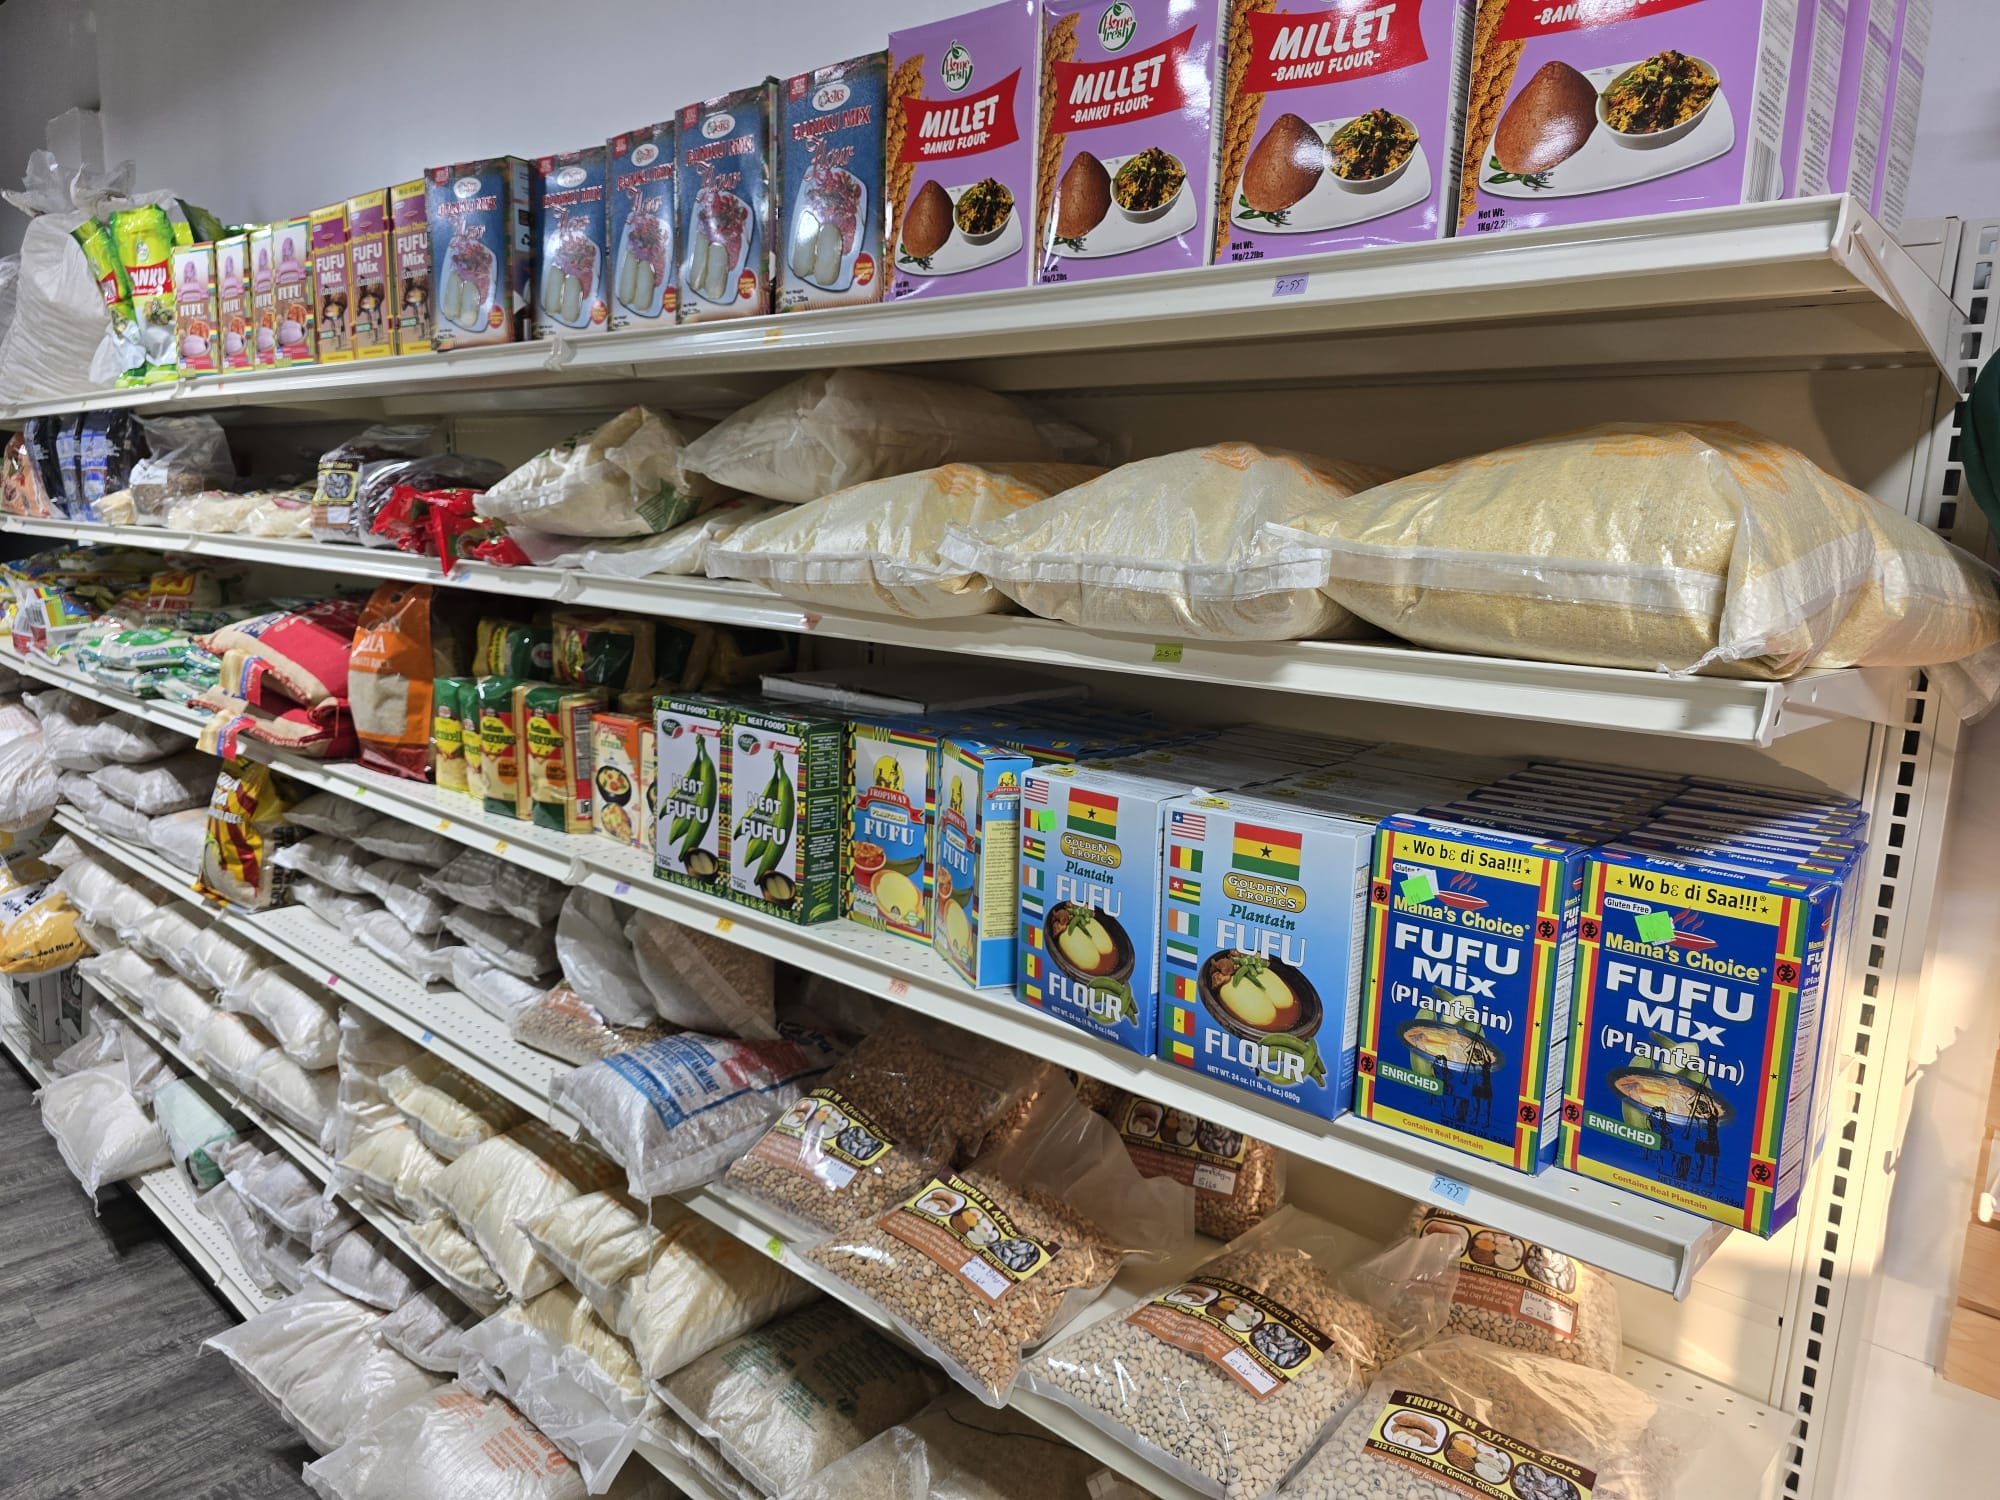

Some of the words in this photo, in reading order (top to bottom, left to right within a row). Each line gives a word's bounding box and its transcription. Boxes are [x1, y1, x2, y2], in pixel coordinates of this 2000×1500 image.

[1103, 14, 1133, 31] Home
[1269, 3, 1396, 61] MILLET
[1069, 55, 1166, 105] MILLET
[792, 112, 840, 142] BANKU
[842, 104, 871, 129] MIX
[919, 96, 999, 138] MILLET
[1478, 208, 1490, 219] Net
[353, 242, 383, 263] FUFU
[397, 232, 428, 254] FUFU
[316, 253, 345, 273] FUFU
[357, 260, 378, 275] Mix
[403, 252, 425, 267] Mix
[321, 271, 342, 285] Mix
[670, 702, 685, 712] NEAT
[686, 705, 708, 716] FOODS
[748, 717, 763, 728] NEAT
[764, 720, 786, 732] FOODS
[672, 773, 704, 794] NEAT
[666, 799, 709, 823] FUFU
[748, 791, 781, 815] NEAT
[741, 819, 786, 846] FUFU
[864, 817, 915, 846] FUFU
[1065, 834, 1108, 854] GOLDEN
[1428, 826, 1463, 837] FUFU
[943, 840, 969, 875] FUFU
[1070, 845, 1115, 865] TROPICS
[1413, 839, 1435, 857] Wo
[1460, 850, 1474, 865] di
[1646, 857, 1687, 871] FUFU
[1065, 860, 1114, 885] Plantain
[1227, 874, 1288, 897] GOLDEN
[1056, 873, 1122, 918] FUFU
[1236, 887, 1297, 910] TROPICS
[1629, 873, 1654, 891] Wo
[1685, 885, 1701, 901] di
[1229, 903, 1296, 931] Plantain
[1393, 894, 1457, 923] Mama's
[1461, 910, 1525, 938] Choice
[1607, 899, 1631, 910] Gluten
[1632, 905, 1650, 914] Free
[1216, 917, 1306, 969] FUFU
[1395, 921, 1521, 976] FUFU
[1605, 931, 1680, 963] Mama's
[1686, 951, 1760, 981] Choice
[1412, 956, 1497, 999] Mix
[1606, 961, 1754, 1022] FUFU
[1049, 972, 1122, 1022] FLOUR
[1391, 980, 1513, 1034] (Plantain)
[1626, 1000, 1725, 1046] Mix
[1204, 1027, 1305, 1085] FLOUR
[1601, 1025, 1745, 1086] (Plantain)
[1207, 1064, 1219, 1074] NET
[1219, 1068, 1231, 1079] WT.
[1231, 1073, 1240, 1081] 24
[1381, 1065, 1439, 1092] ENRICHED
[1402, 1118, 1434, 1135] Contains
[1434, 1128, 1451, 1140] Real
[1452, 1134, 1484, 1150] Plantain
[1589, 1115, 1655, 1146] ENRICHED
[948, 1174, 986, 1203] TRIPPLE
[983, 1199, 995, 1211] M
[1613, 1172, 1649, 1190] Contains
[1651, 1186, 1669, 1197] Real
[1671, 1193, 1708, 1211] Plantain
[1240, 1287, 1250, 1298] M
[1250, 1293, 1291, 1322] African
[1291, 1317, 1322, 1344] Store
[1405, 1394, 1463, 1422] TRIPPLE
[1464, 1420, 1479, 1431] M
[1481, 1428, 1537, 1459] African
[1540, 1454, 1582, 1479] Store
[1388, 1445, 1409, 1457] Great
[1409, 1451, 1431, 1466] Brook
[1432, 1459, 1445, 1473] Rd,
[1446, 1467, 1474, 1486] Groton,
[1475, 1481, 1509, 1500] Ct06340
[1448, 1484, 1475, 1499] African
